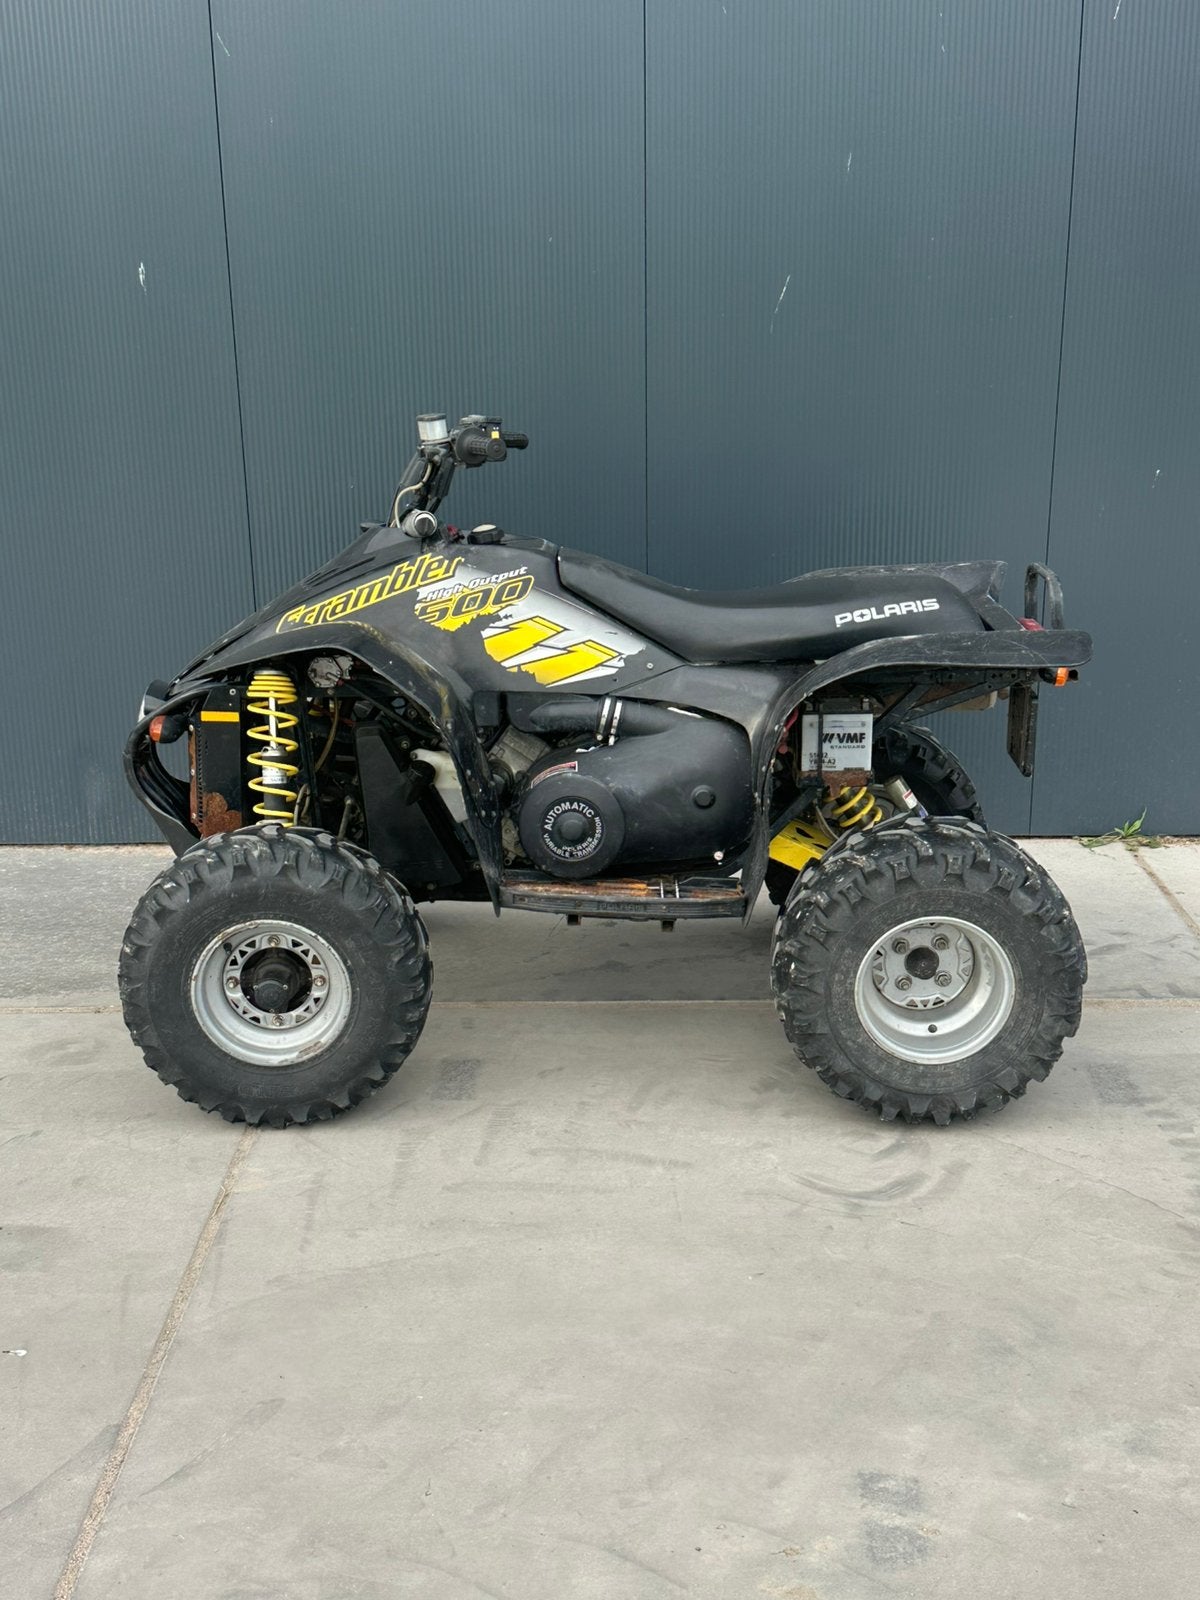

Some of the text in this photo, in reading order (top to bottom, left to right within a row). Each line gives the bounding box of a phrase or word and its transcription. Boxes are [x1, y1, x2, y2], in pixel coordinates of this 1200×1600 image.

[425, 566, 529, 601] High Output
[415, 575, 535, 625] 500
[834, 598, 940, 628] POLARIS
[836, 732, 866, 744] VMF
[543, 801, 595, 831] AUTOMATIC
[543, 833, 570, 858] VARIABLE
